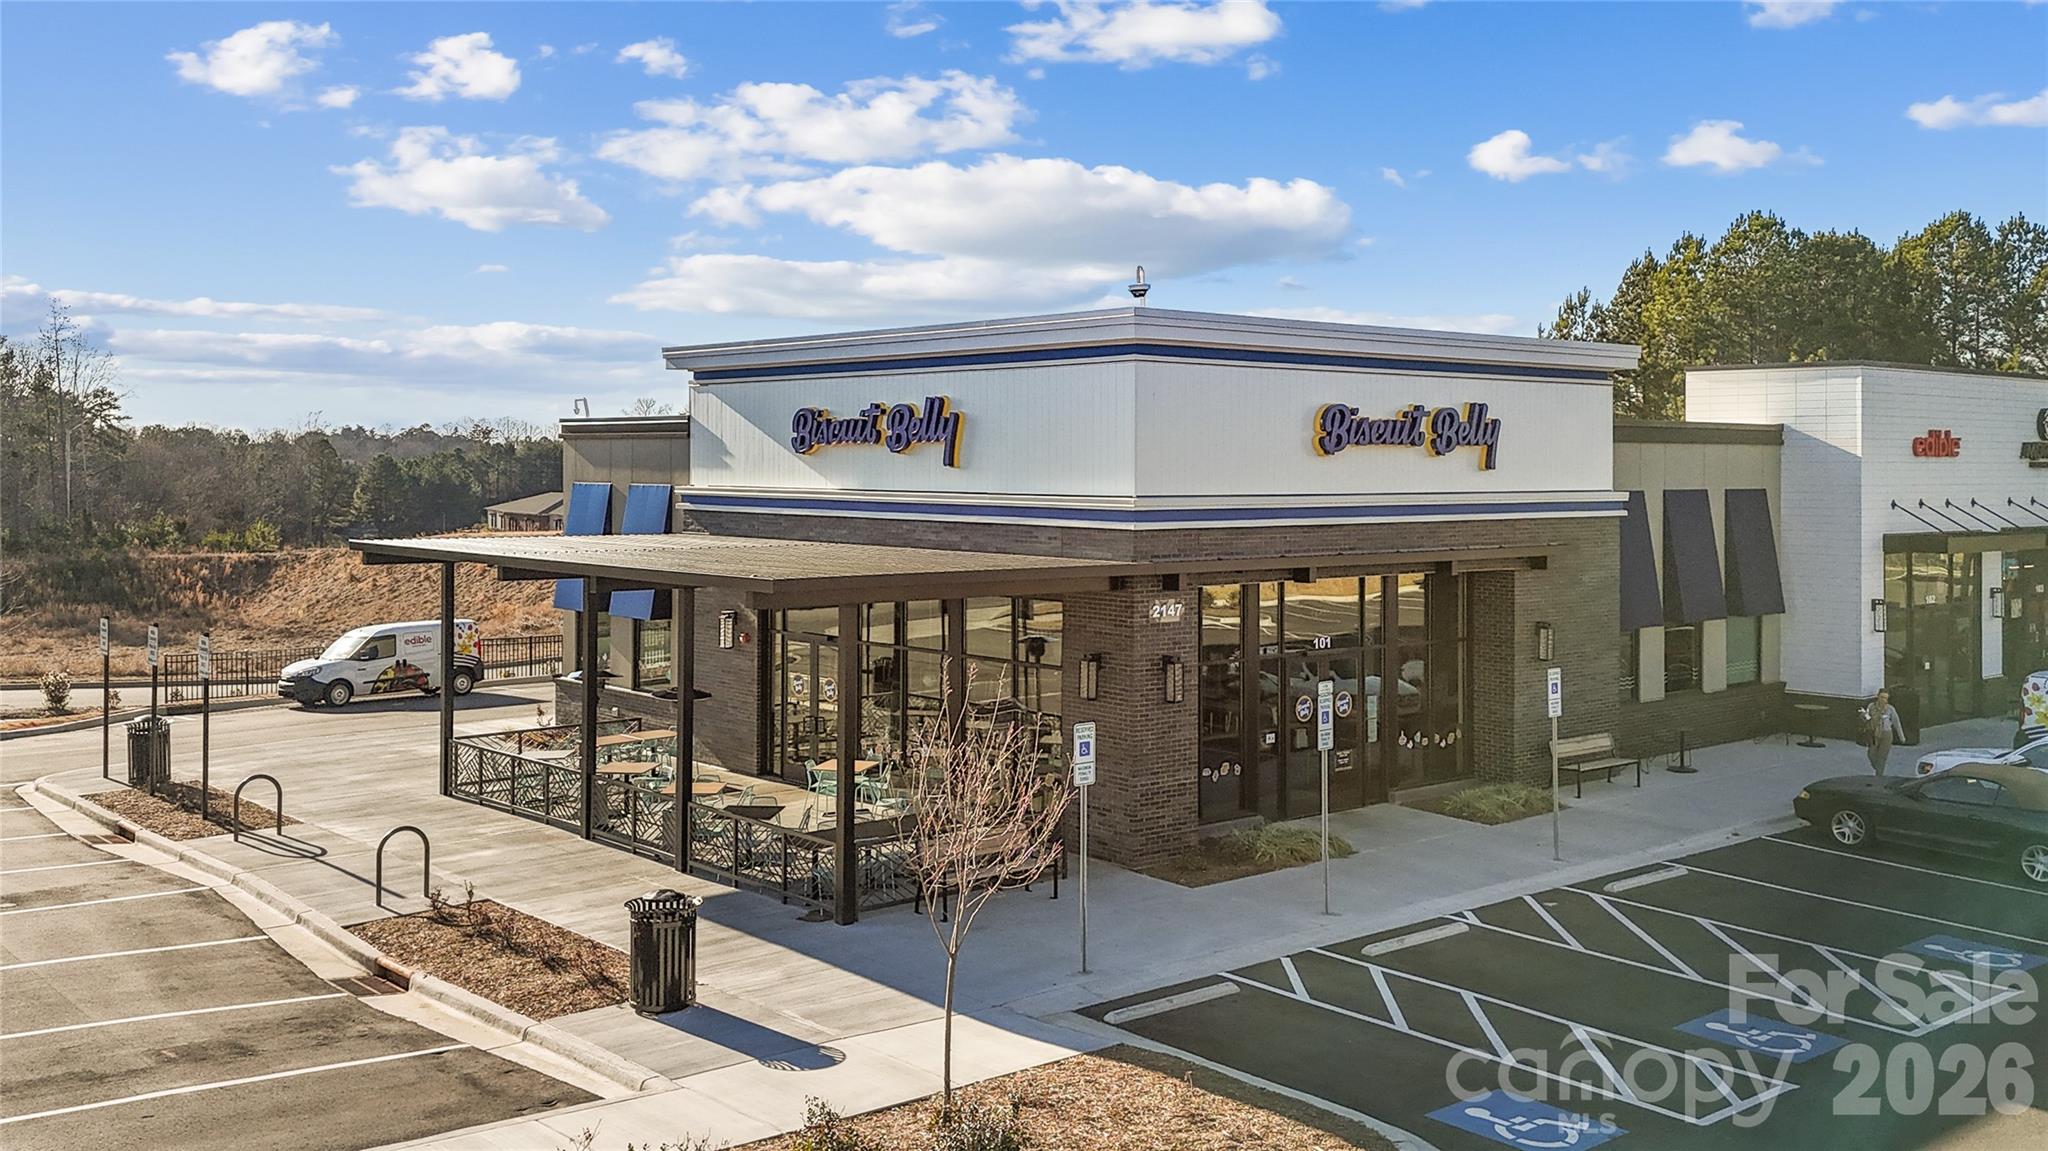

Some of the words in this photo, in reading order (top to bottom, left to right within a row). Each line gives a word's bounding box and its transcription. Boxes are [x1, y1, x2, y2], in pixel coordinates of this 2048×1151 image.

[791, 402, 886, 455] Biscuit
[886, 395, 965, 468] Belly
[1312, 403, 1430, 456] Biscuit
[1425, 402, 1501, 471] Belly
[1912, 430, 1961, 457] edible
[1152, 603, 1183, 618] 2147
[404, 634, 432, 646] edible
[1313, 636, 1331, 649] 101
